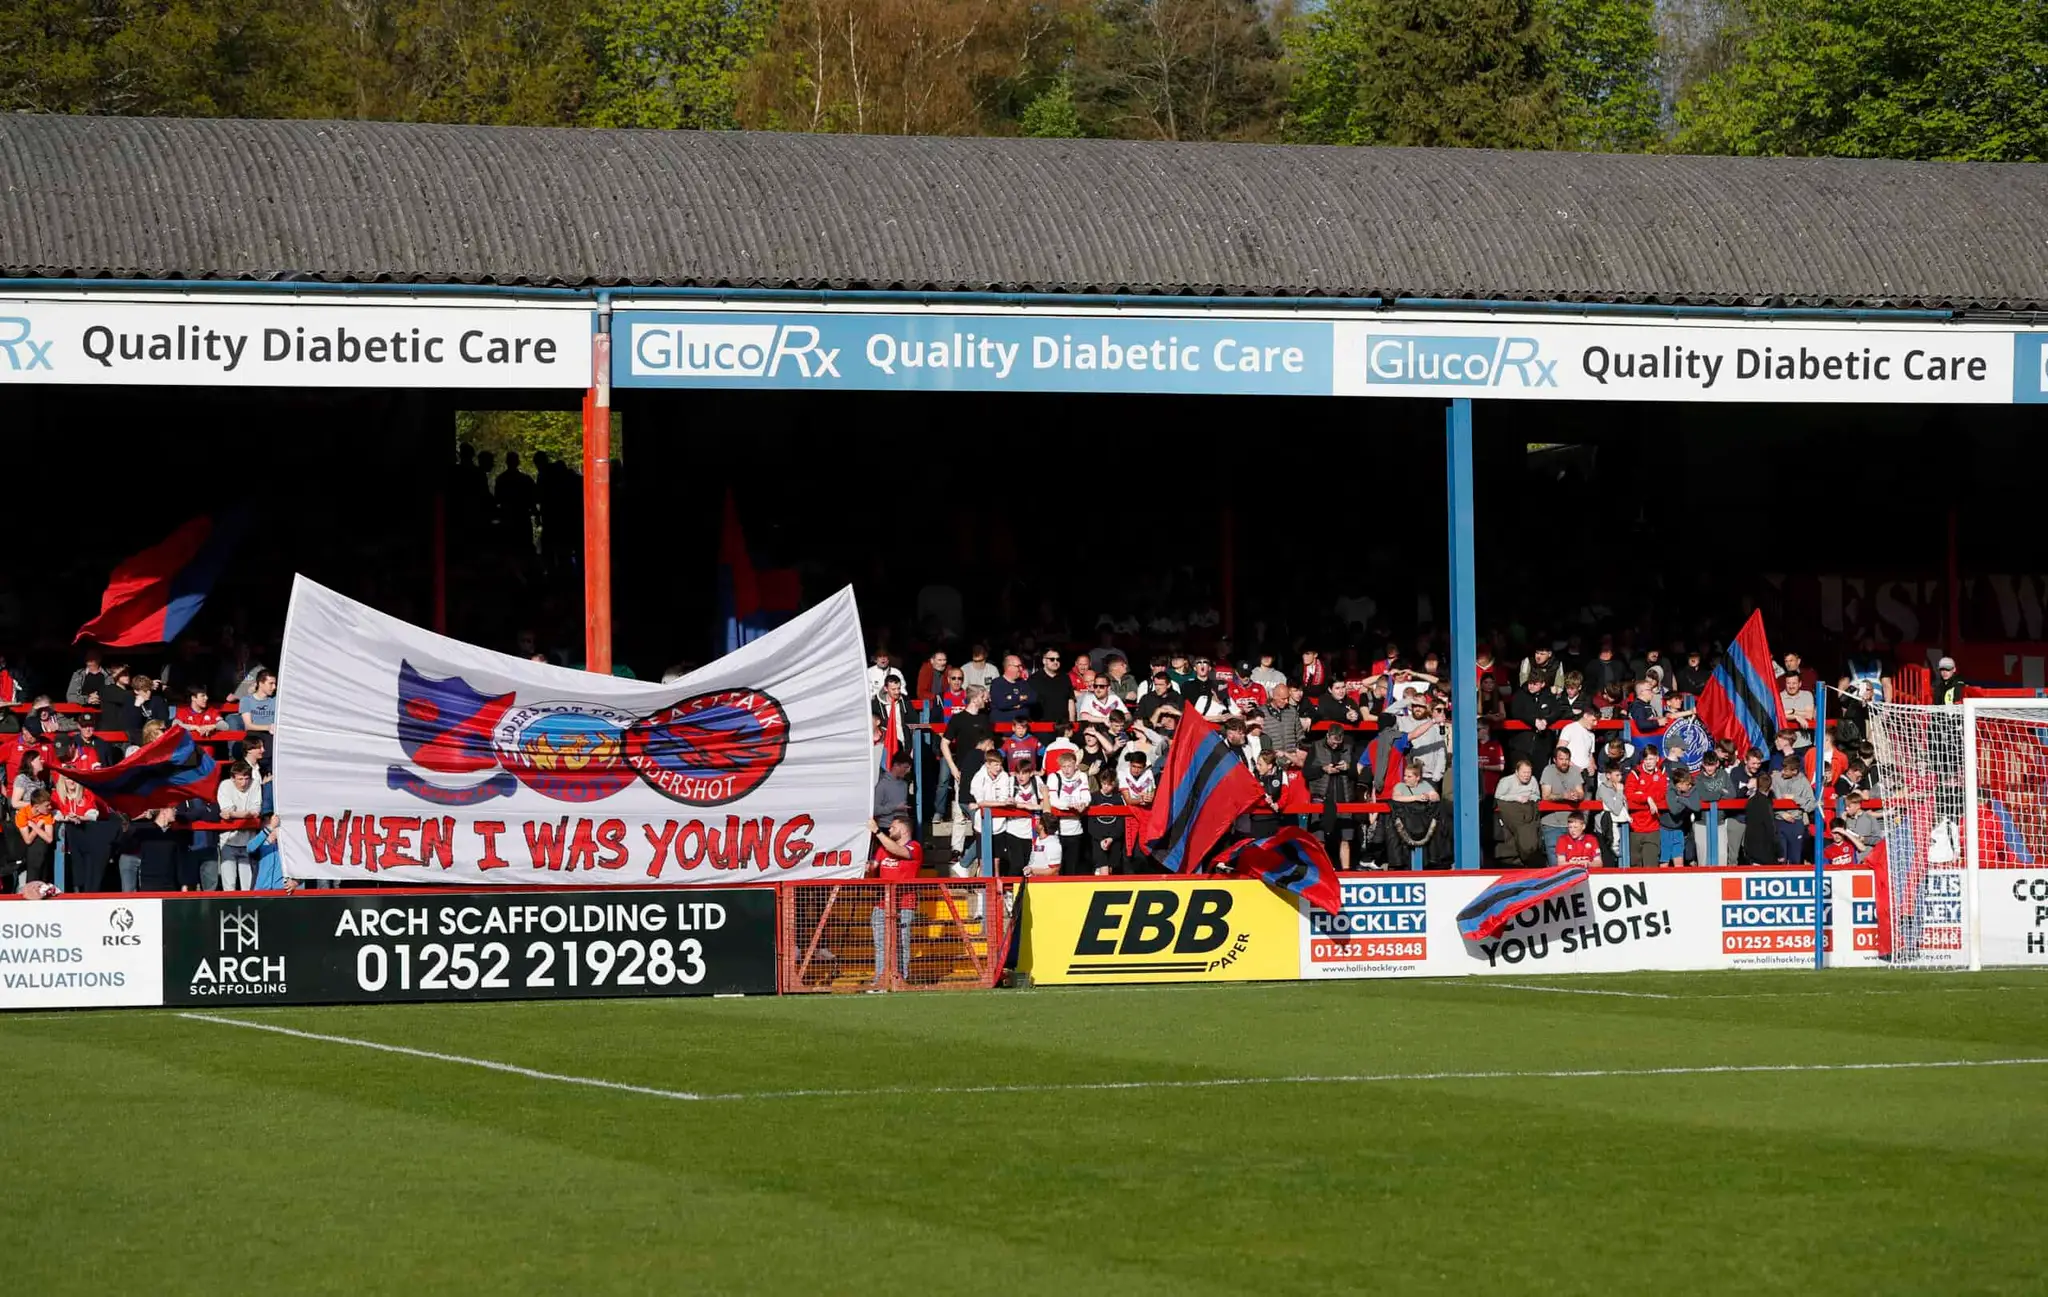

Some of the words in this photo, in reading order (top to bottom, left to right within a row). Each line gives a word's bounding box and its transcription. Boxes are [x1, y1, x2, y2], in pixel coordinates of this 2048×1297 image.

[82, 326, 247, 371] Quality
[264, 328, 443, 364] Diabetic
[459, 330, 557, 364] Care
[866, 332, 1019, 377] Quality
[1034, 336, 1199, 371] Diabetic
[1212, 340, 1304, 373] Care
[1582, 345, 1723, 387] Quality
[1737, 348, 1890, 381] Diabetic
[1904, 350, 1987, 382] Care
[304, 809, 456, 872] WHEN
[473, 820, 509, 871] I
[522, 816, 629, 871] WAS
[642, 814, 851, 878] YOUNG...
[1341, 885, 1425, 904] HOLLIS
[1597, 881, 1648, 912] ON
[2, 922, 62, 939] SIONS
[334, 908, 429, 937] ARCH
[438, 903, 668, 936] SCAFFOLDING
[678, 903, 727, 931] LTD
[1074, 889, 1234, 956] EBB
[1314, 913, 1425, 932] HOCKLEY
[102, 935, 141, 946] RICS
[1480, 933, 1549, 968] YOU
[1560, 909, 1672, 954] SHOTS!
[1726, 936, 1772, 949] 01252
[1775, 935, 1829, 948] 54588
[0, 947, 83, 964] AWARDS
[1208, 932, 1250, 972] PAPER
[1314, 944, 1362, 958] 01252
[1366, 943, 1423, 956] 545848
[1733, 956, 1816, 967] www.hollishockley.co
[191, 955, 285, 983] ARCH
[356, 941, 510, 992] 01252
[525, 937, 707, 988] 219283
[1321, 963, 1416, 974] www.hollishockley.com
[4, 971, 126, 989] VALUATIONS
[190, 983, 287, 996] SCAFFOLDING
